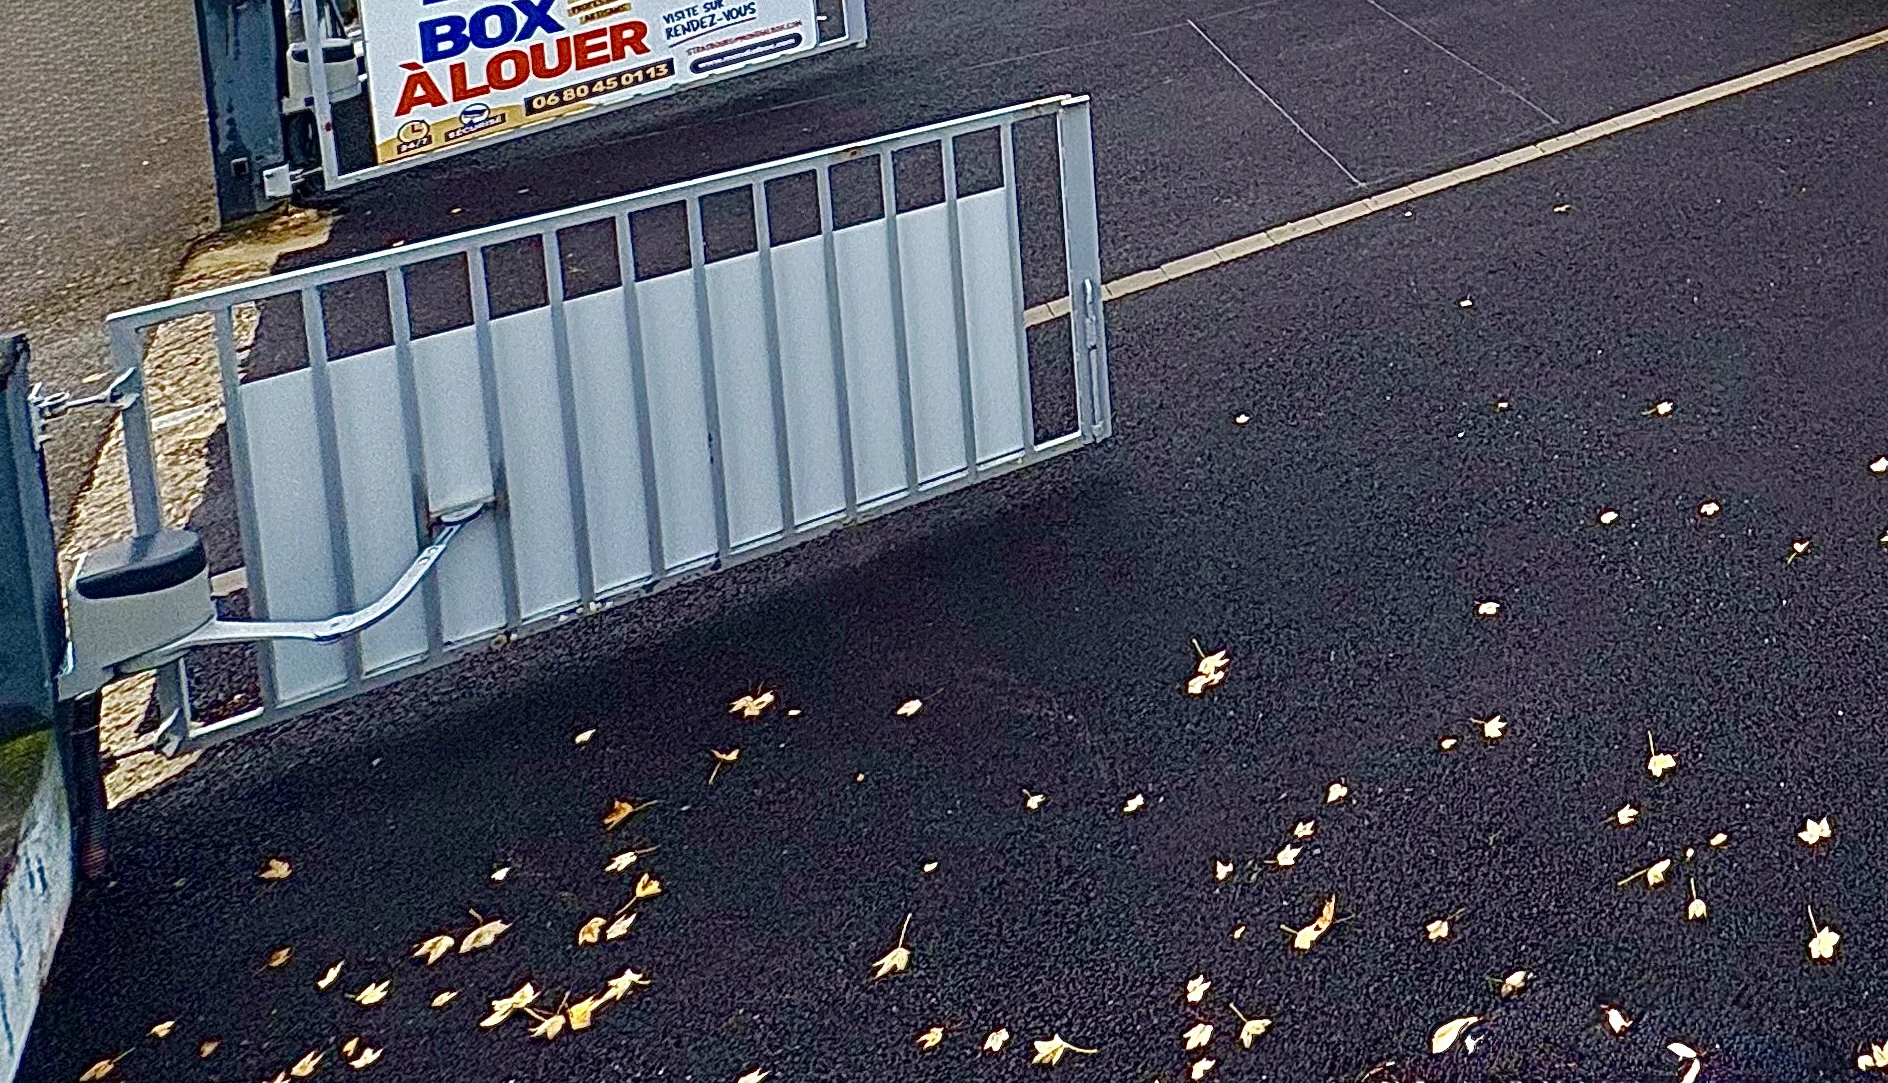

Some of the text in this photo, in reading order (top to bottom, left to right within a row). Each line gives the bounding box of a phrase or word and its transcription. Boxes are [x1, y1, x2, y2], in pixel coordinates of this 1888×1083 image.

[663, 4, 699, 24] VISITE
[666, 2, 756, 40] RENDEZ-VOUS
[395, 21, 651, 116] À LOUER
[532, 64, 668, 110] 06 80 45 01 13
